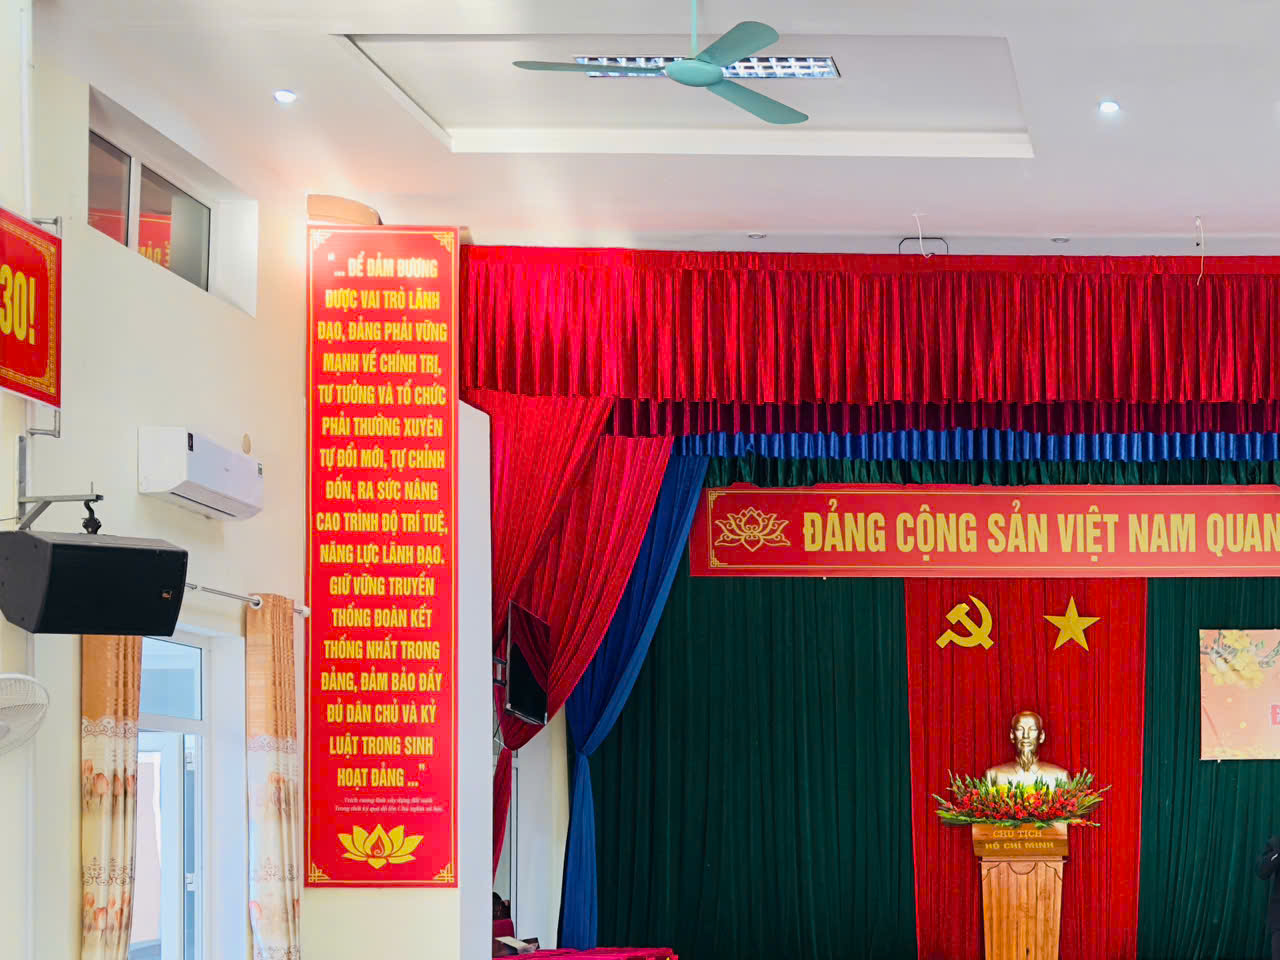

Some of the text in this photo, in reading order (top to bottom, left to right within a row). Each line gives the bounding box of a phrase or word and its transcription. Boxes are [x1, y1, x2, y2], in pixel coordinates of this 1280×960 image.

[359, 289, 381, 310] VAI
[316, 512, 341, 532] CAO
[803, 498, 886, 552] ĐẢNG
[895, 503, 978, 562] CỘNG
[987, 499, 1048, 553] SẢN
[1057, 505, 1119, 562] VIỆT
[1128, 513, 1196, 553] NAM
[399, 640, 441, 660] TRONG
[361, 736, 402, 756] TRONG
[403, 736, 435, 756] SINH
